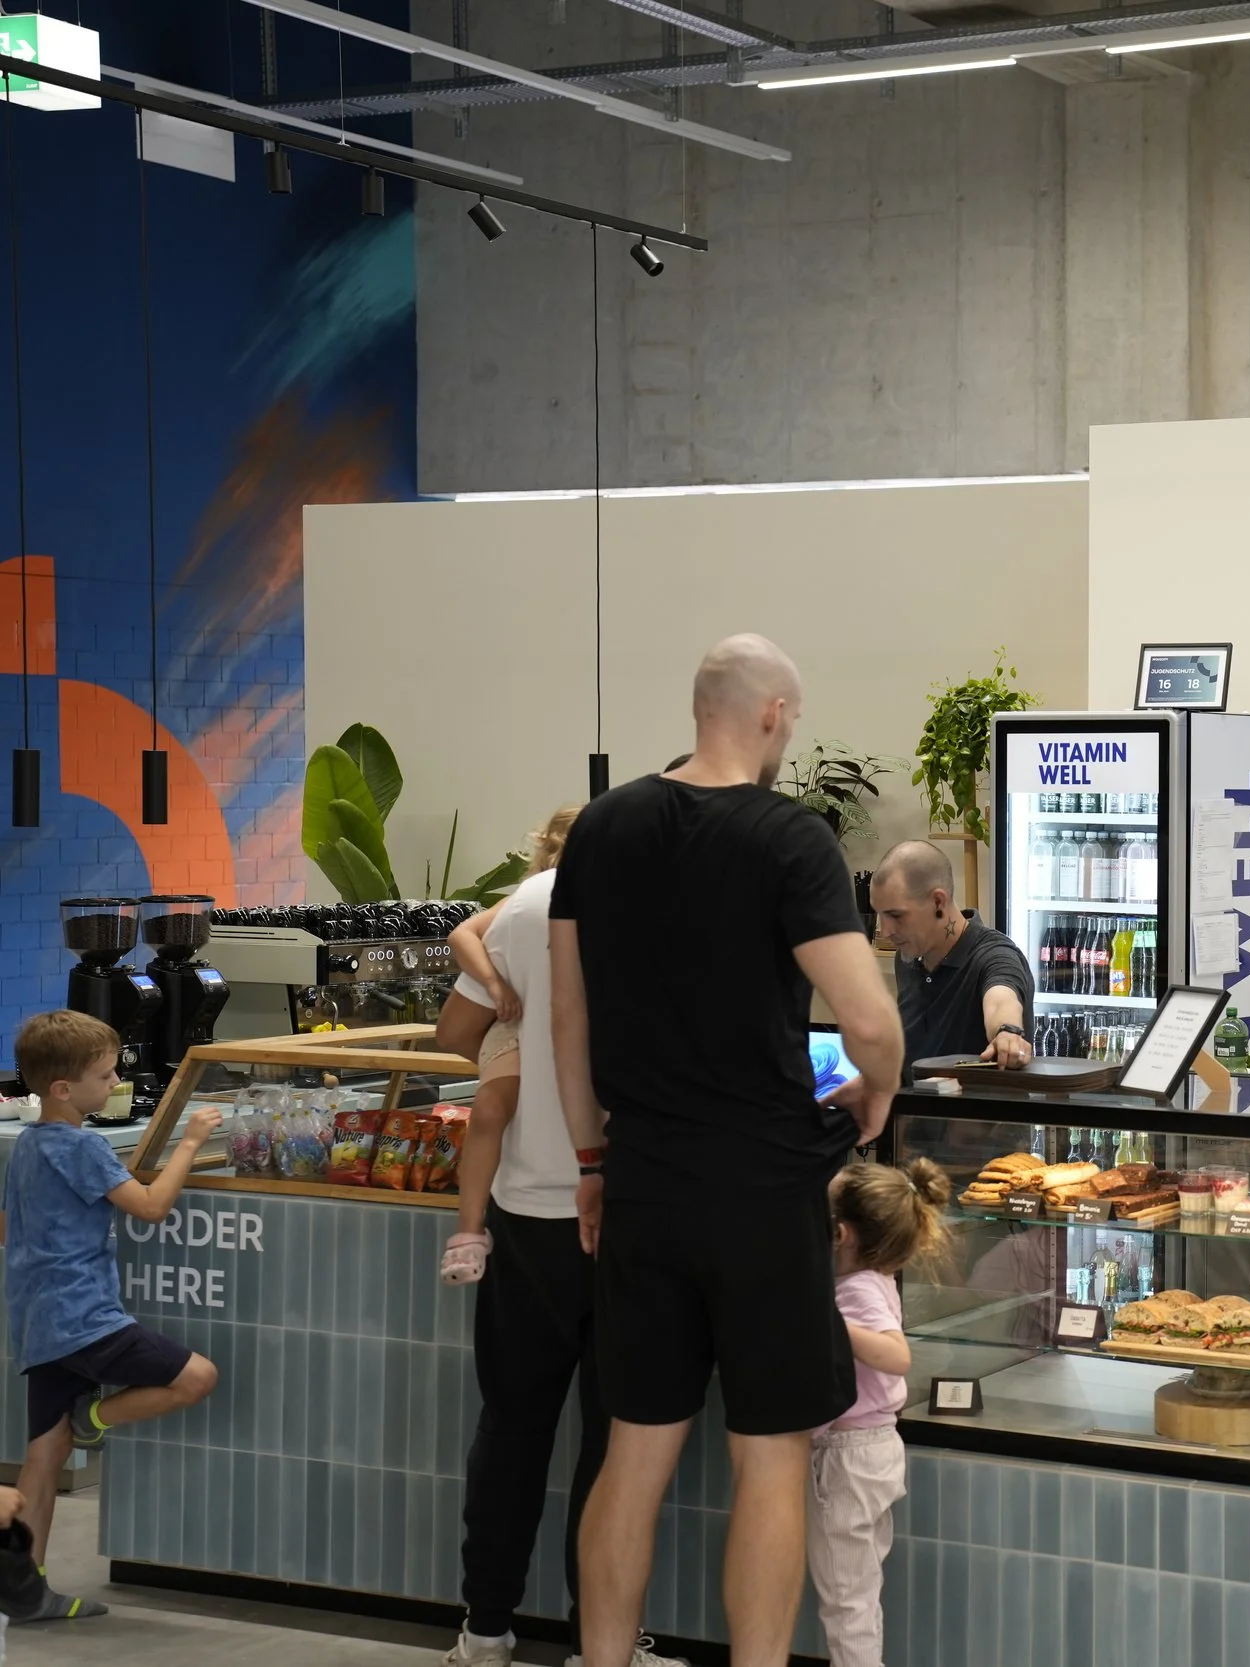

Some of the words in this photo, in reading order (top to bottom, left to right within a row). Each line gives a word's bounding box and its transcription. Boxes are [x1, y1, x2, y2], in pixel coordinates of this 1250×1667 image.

[1159, 679, 1171, 689] 16
[1187, 678, 1200, 689] 18
[1038, 742, 1127, 763] VITAMIN
[1038, 765, 1091, 785] WELL
[125, 1208, 265, 1252] ORDER
[126, 1264, 226, 1307] HERE
